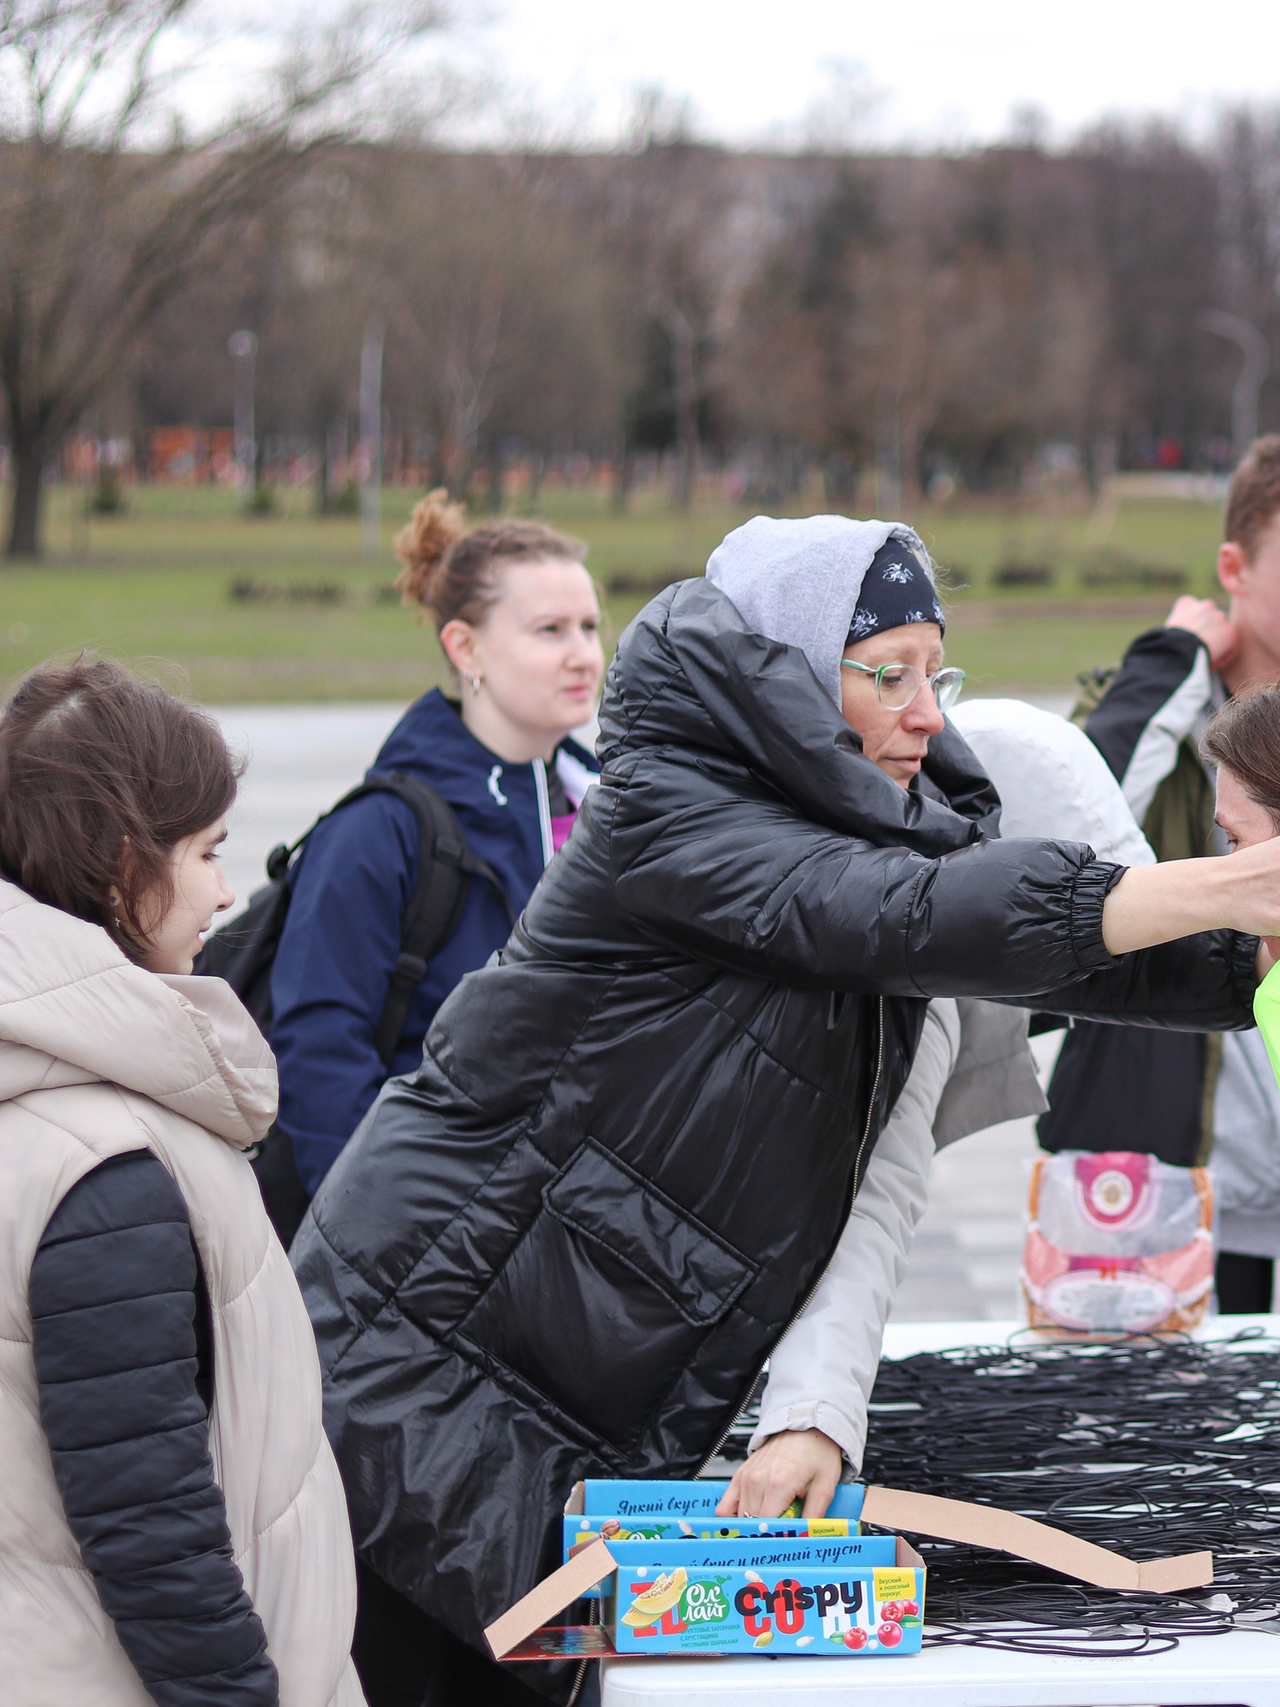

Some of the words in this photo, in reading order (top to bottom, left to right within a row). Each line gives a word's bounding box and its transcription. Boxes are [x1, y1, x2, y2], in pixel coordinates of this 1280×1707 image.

[617, 1498, 664, 1516] Яркий
[667, 1496, 699, 1516] вкус
[702, 1498, 710, 1508] и
[750, 1547, 811, 1566] нежный
[814, 1544, 862, 1564] хруст
[879, 1576, 901, 1585] Вкусный
[883, 1582, 910, 1591] полезный
[734, 1578, 863, 1618] Crispy
[682, 1603, 727, 1622] лайт
